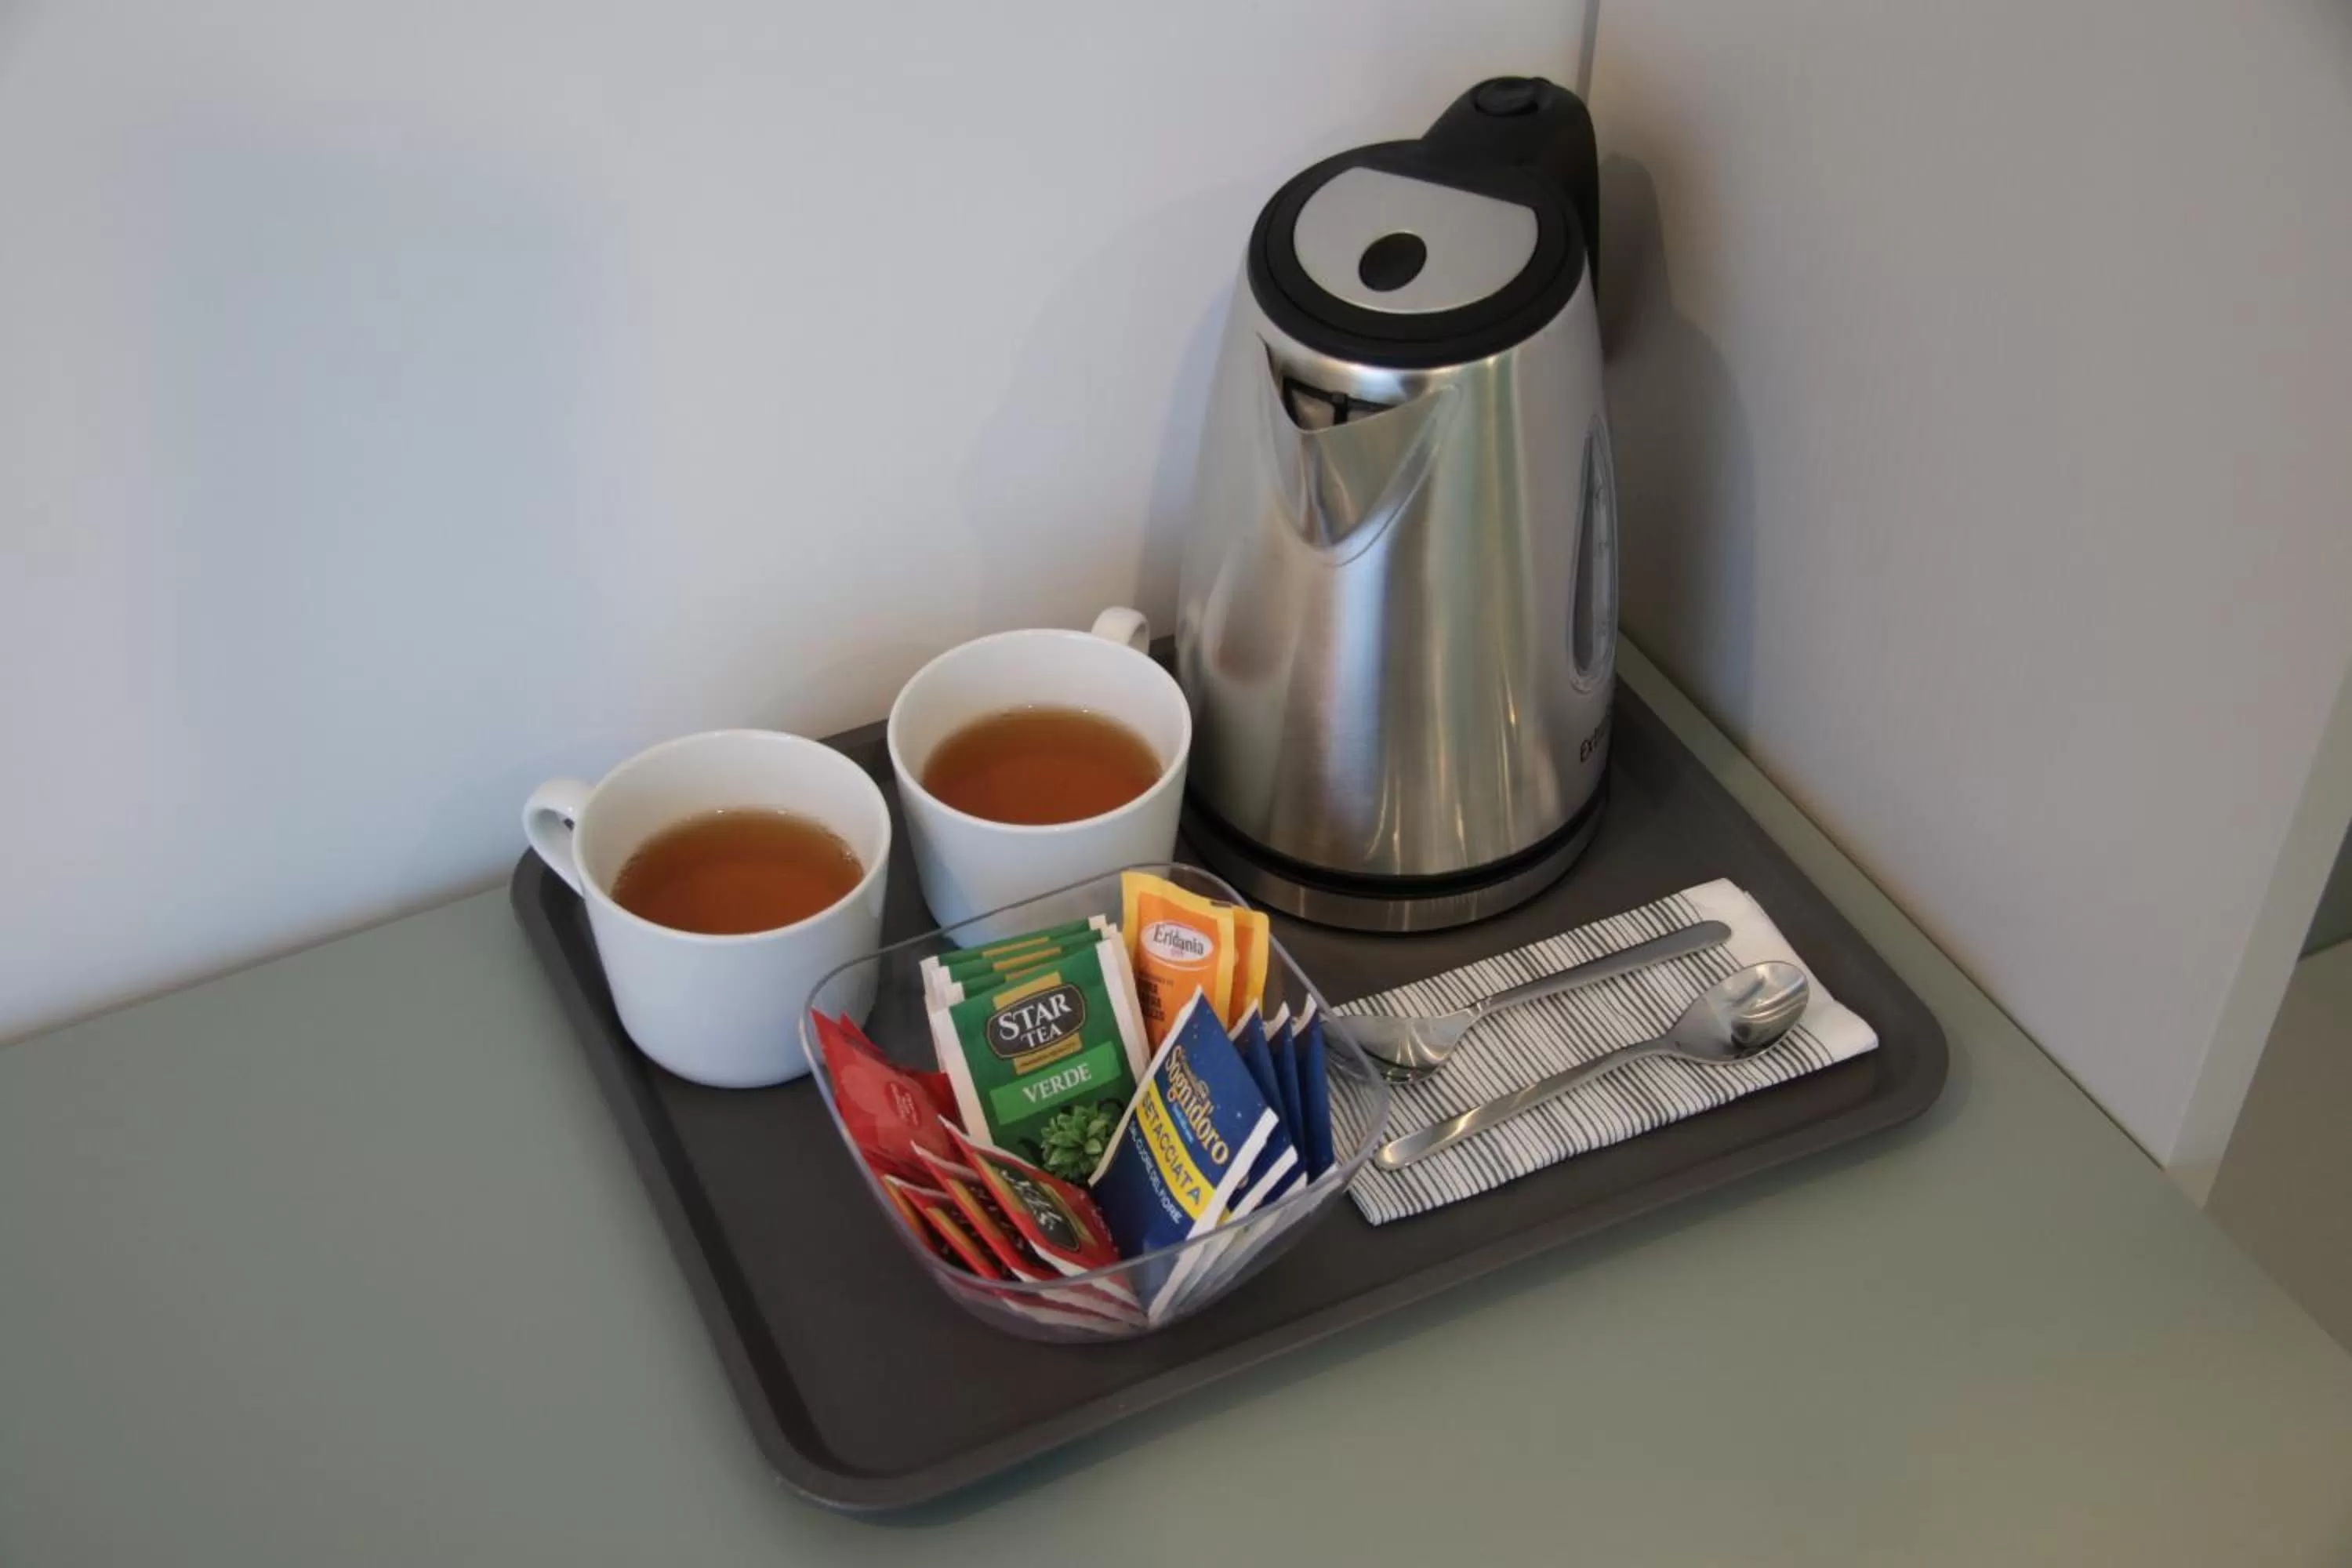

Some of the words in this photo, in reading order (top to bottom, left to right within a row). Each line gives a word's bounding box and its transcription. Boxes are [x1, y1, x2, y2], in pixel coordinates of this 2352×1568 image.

[1153, 924, 1204, 955] Eridania
[996, 993, 1073, 1040] STAR
[1020, 1024, 1062, 1047] TEA
[1022, 1062, 1092, 1104] VERDE
[1142, 1091, 1201, 1205] SETACCIATA
